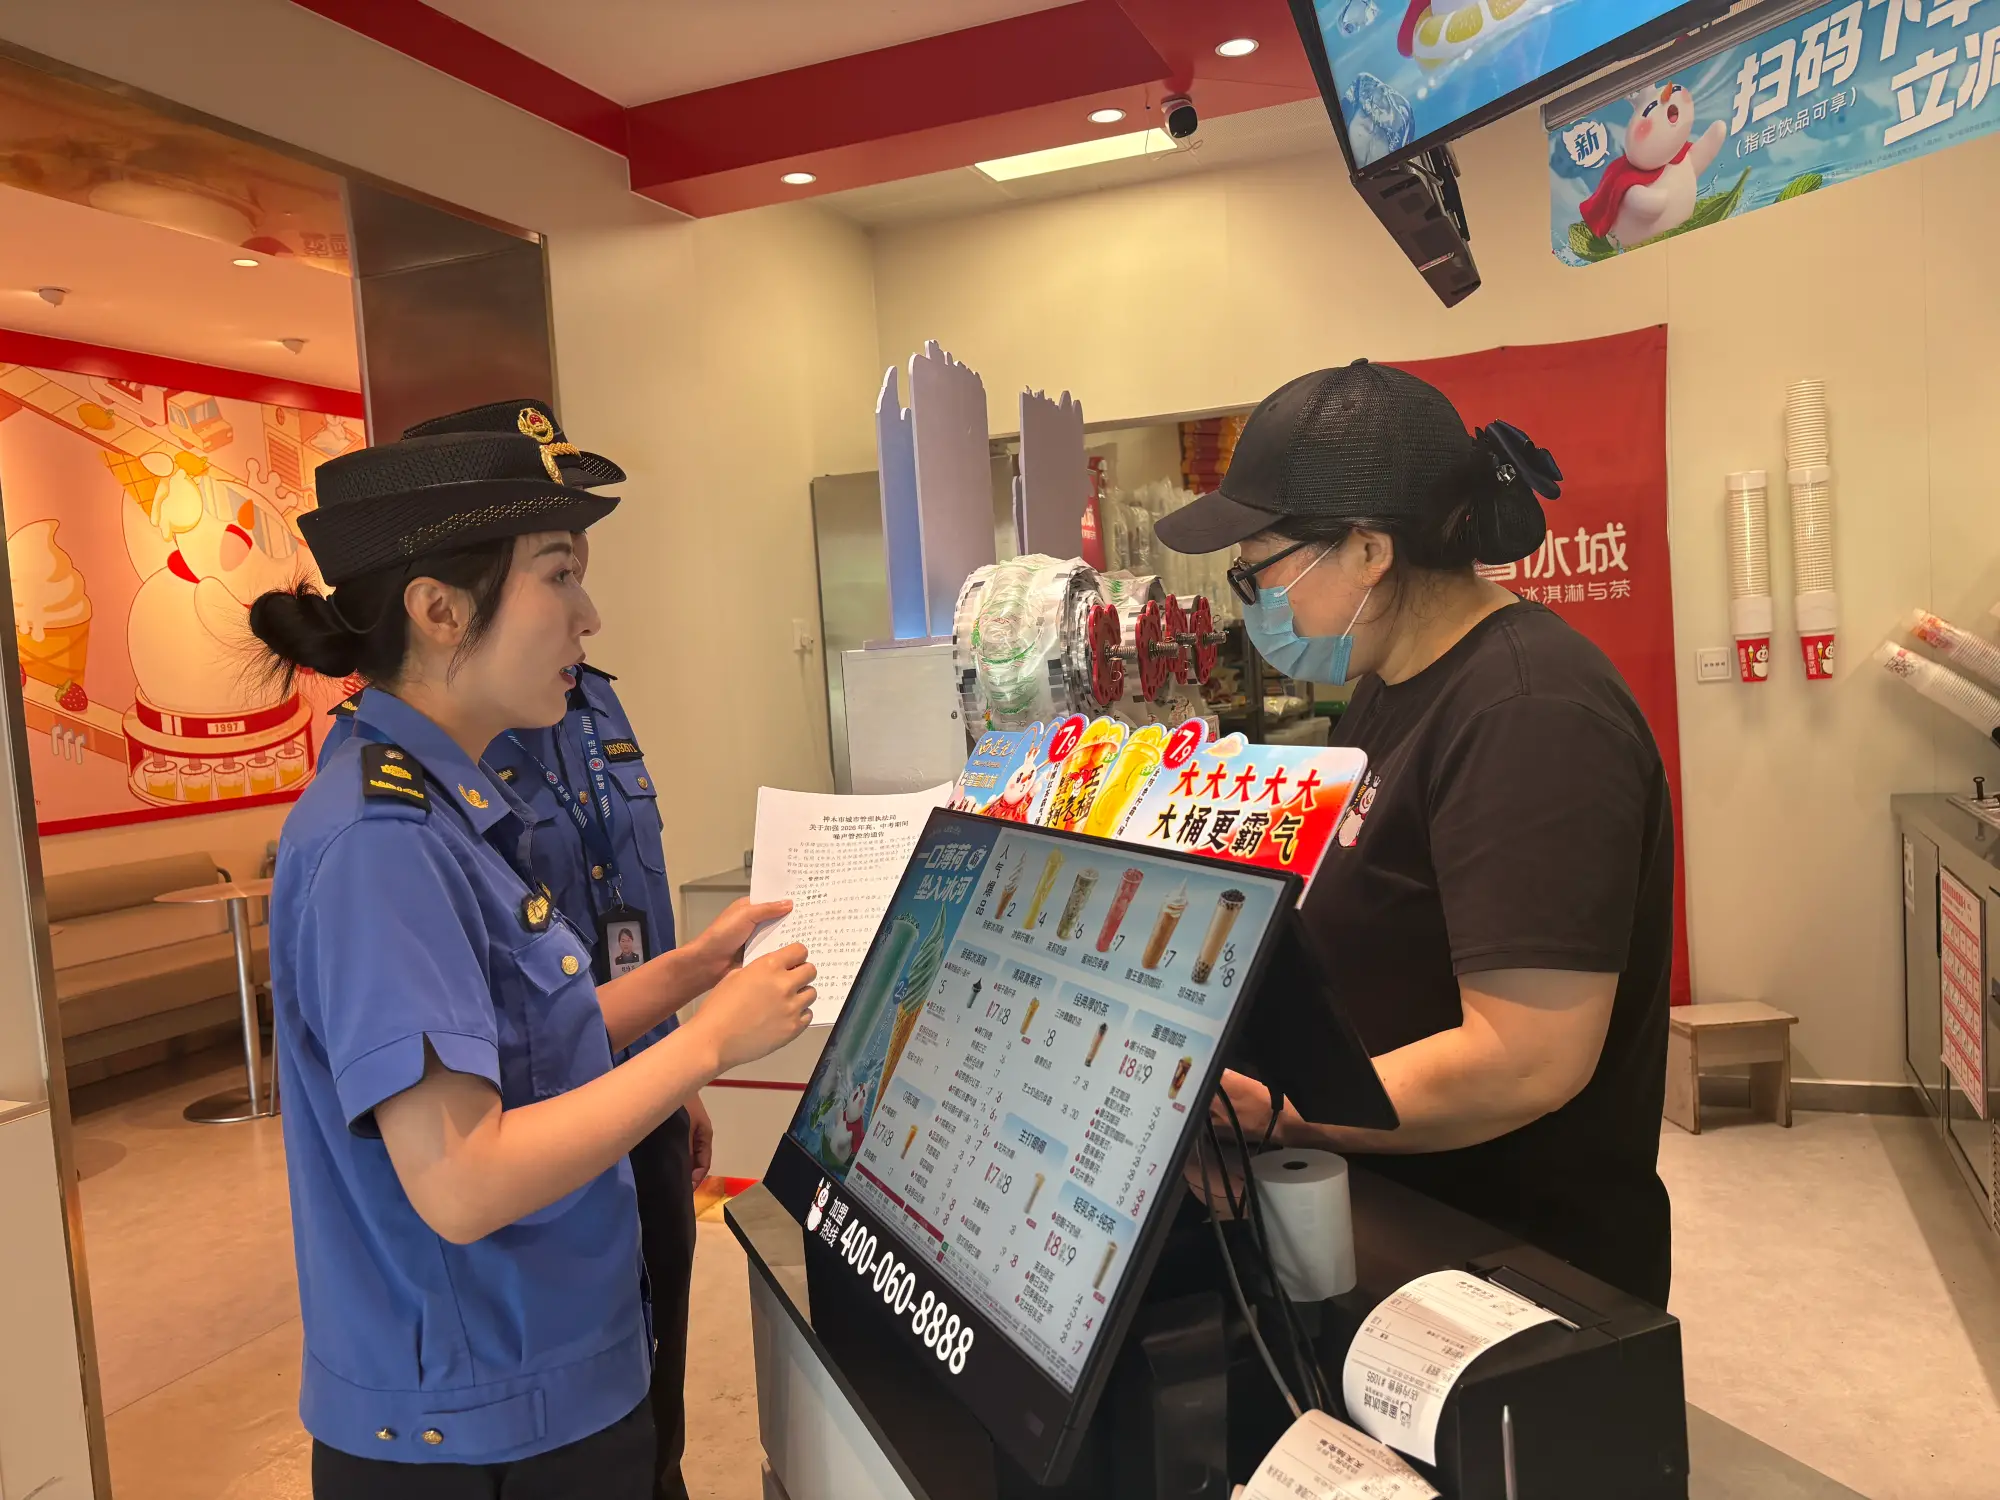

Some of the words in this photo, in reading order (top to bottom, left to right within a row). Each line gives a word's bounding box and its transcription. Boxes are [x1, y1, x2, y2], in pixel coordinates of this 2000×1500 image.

[1735, 87, 1858, 158] (指定饮品可享)
[1574, 129, 1602, 163] 新
[1476, 522, 1629, 582] 冰城
[1170, 761, 1322, 810] 大大大大大
[822, 813, 897, 824] 神木市城市管理执法局
[1147, 802, 1304, 863] 大桶更霸气
[914, 874, 973, 905] 坠入冰河
[975, 844, 1010, 916] 人气爆品
[1071, 992, 1110, 1017] 经典厚奶茶
[819, 1217, 840, 1248] 热线
[828, 1197, 850, 1227] 加盟
[840, 1218, 974, 1375] 400-060-8888
